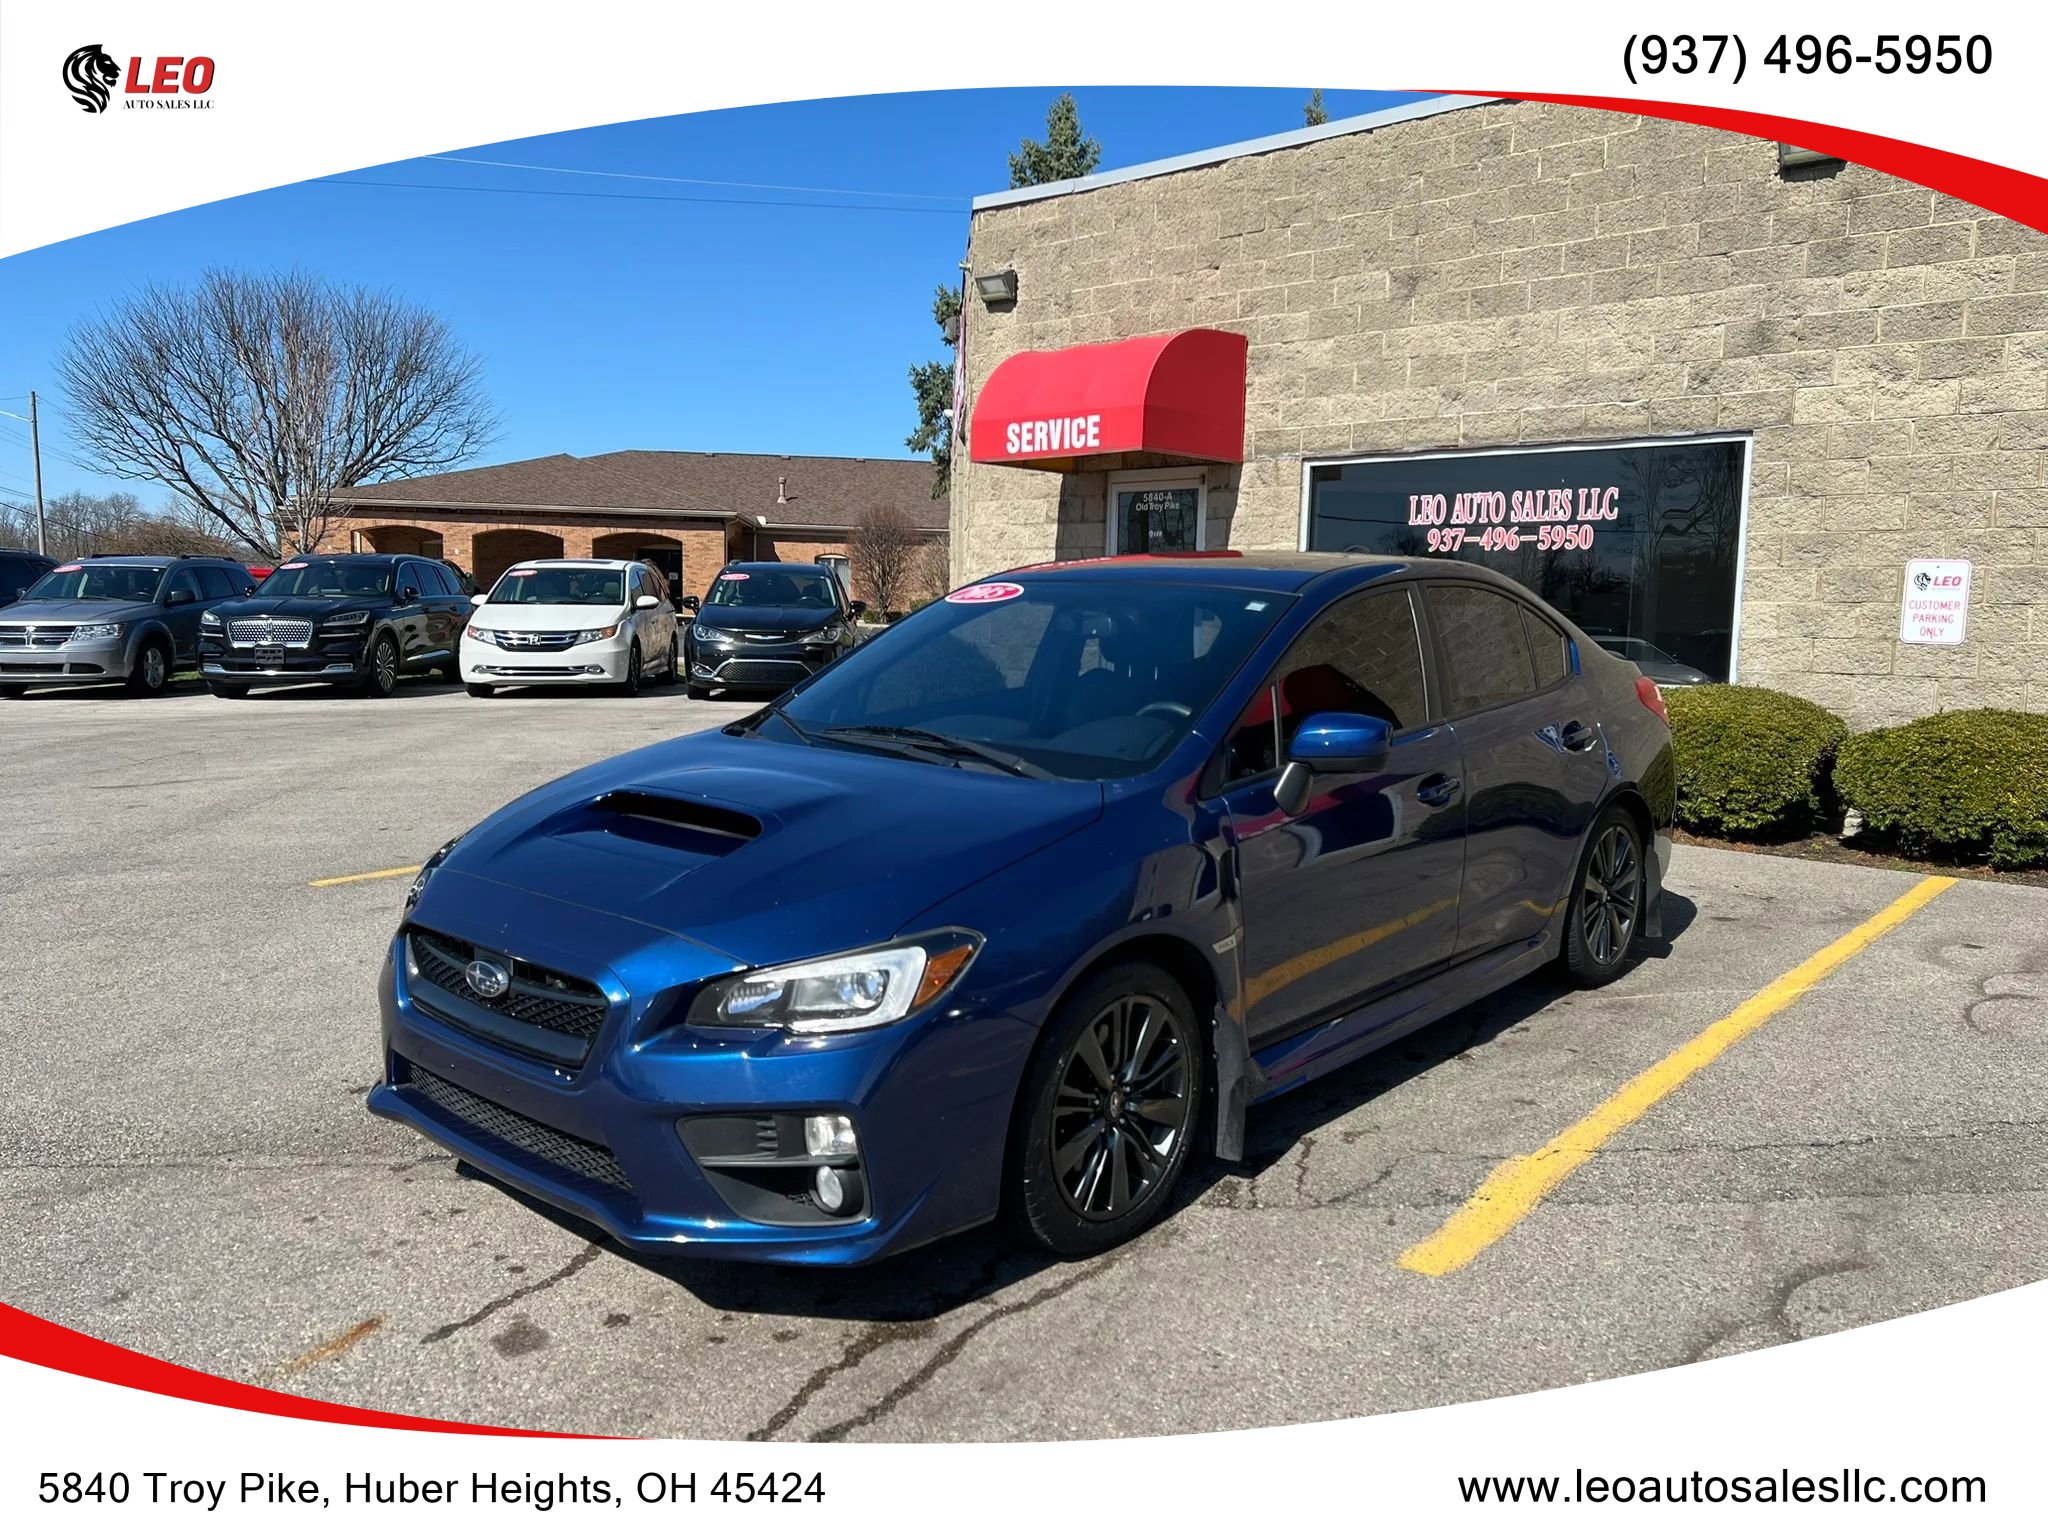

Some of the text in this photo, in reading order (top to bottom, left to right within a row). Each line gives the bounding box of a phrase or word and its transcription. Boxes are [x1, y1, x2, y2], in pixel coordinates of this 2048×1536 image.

[1006, 414, 1101, 454] SERVICE
[1143, 491, 1173, 502] 5840-A
[1135, 501, 1180, 512] Old Troy Pike
[1408, 486, 1619, 526] LEO AUTO SALES LLC
[1427, 524, 1594, 552] 937-496-5950
[1932, 575, 1962, 587] LEO
[1908, 599, 1961, 611] CUSTOMER
[1912, 613, 1955, 624] PARKING
[1919, 626, 1945, 637] ONLY
